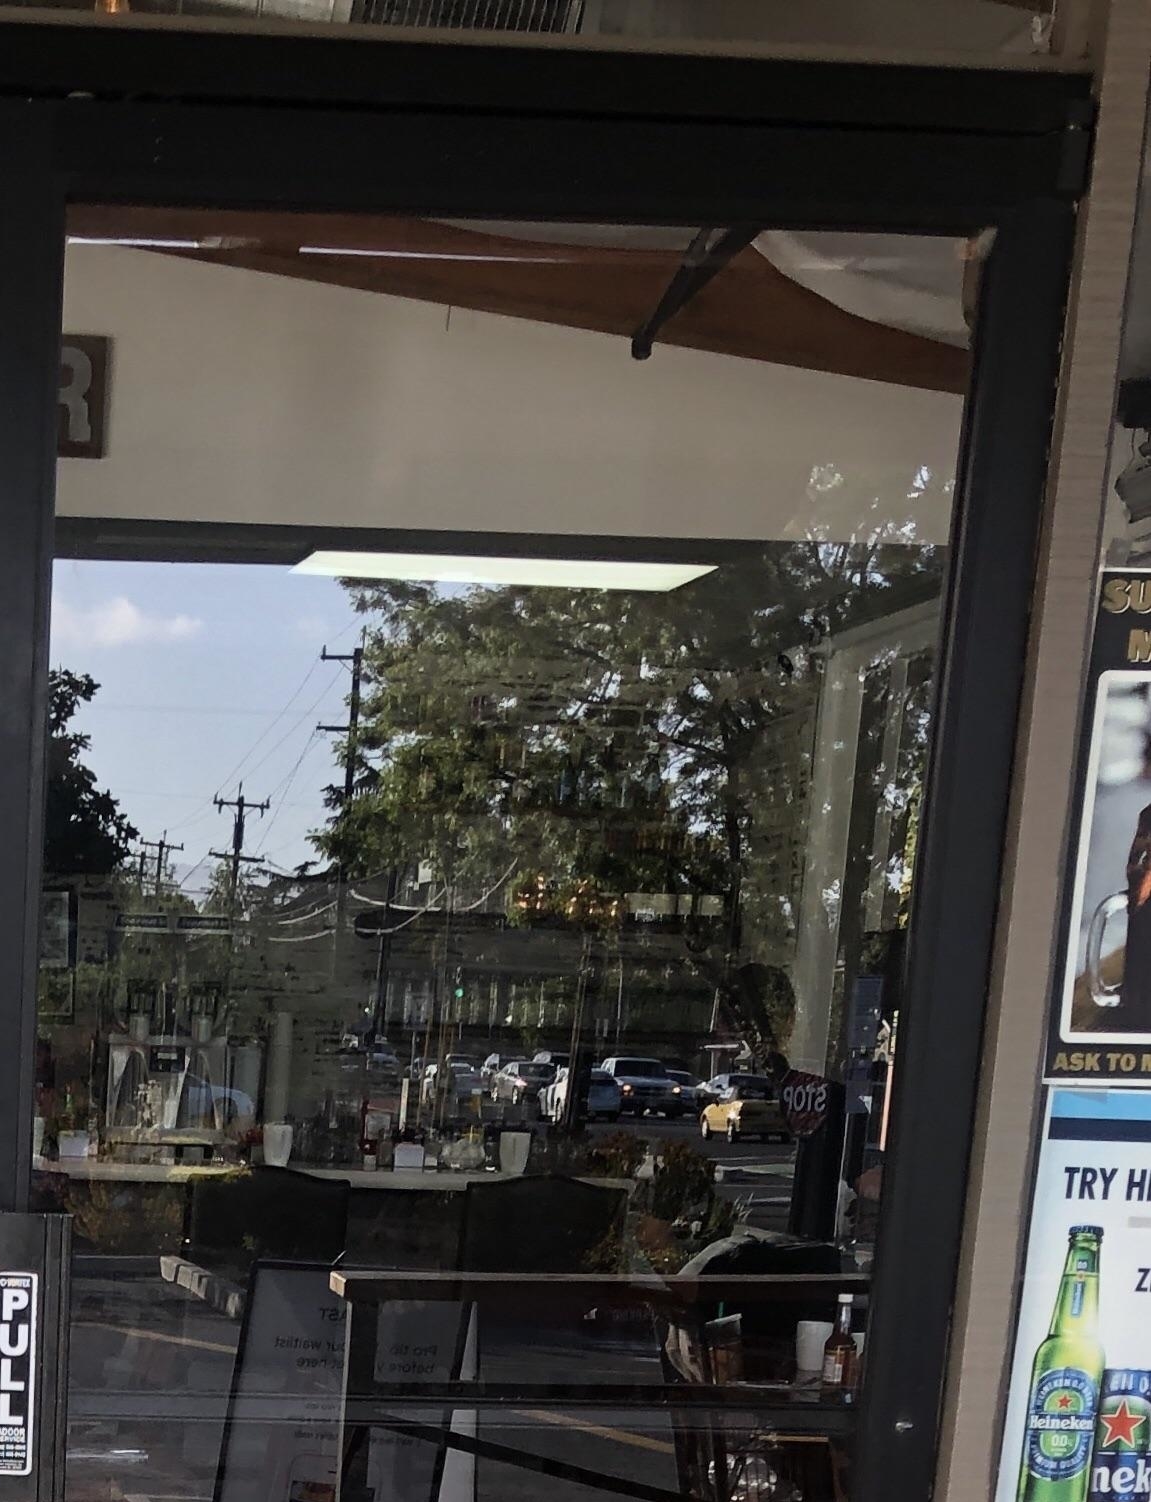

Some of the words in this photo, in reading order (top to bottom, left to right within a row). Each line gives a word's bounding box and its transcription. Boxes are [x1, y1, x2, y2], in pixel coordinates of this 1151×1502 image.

[1052, 1052, 1101, 1072] ASK
[1106, 1052, 1137, 1072] TO
[1064, 1166, 1119, 1200] TRY
[1029, 1414, 1094, 1430] Heineken
